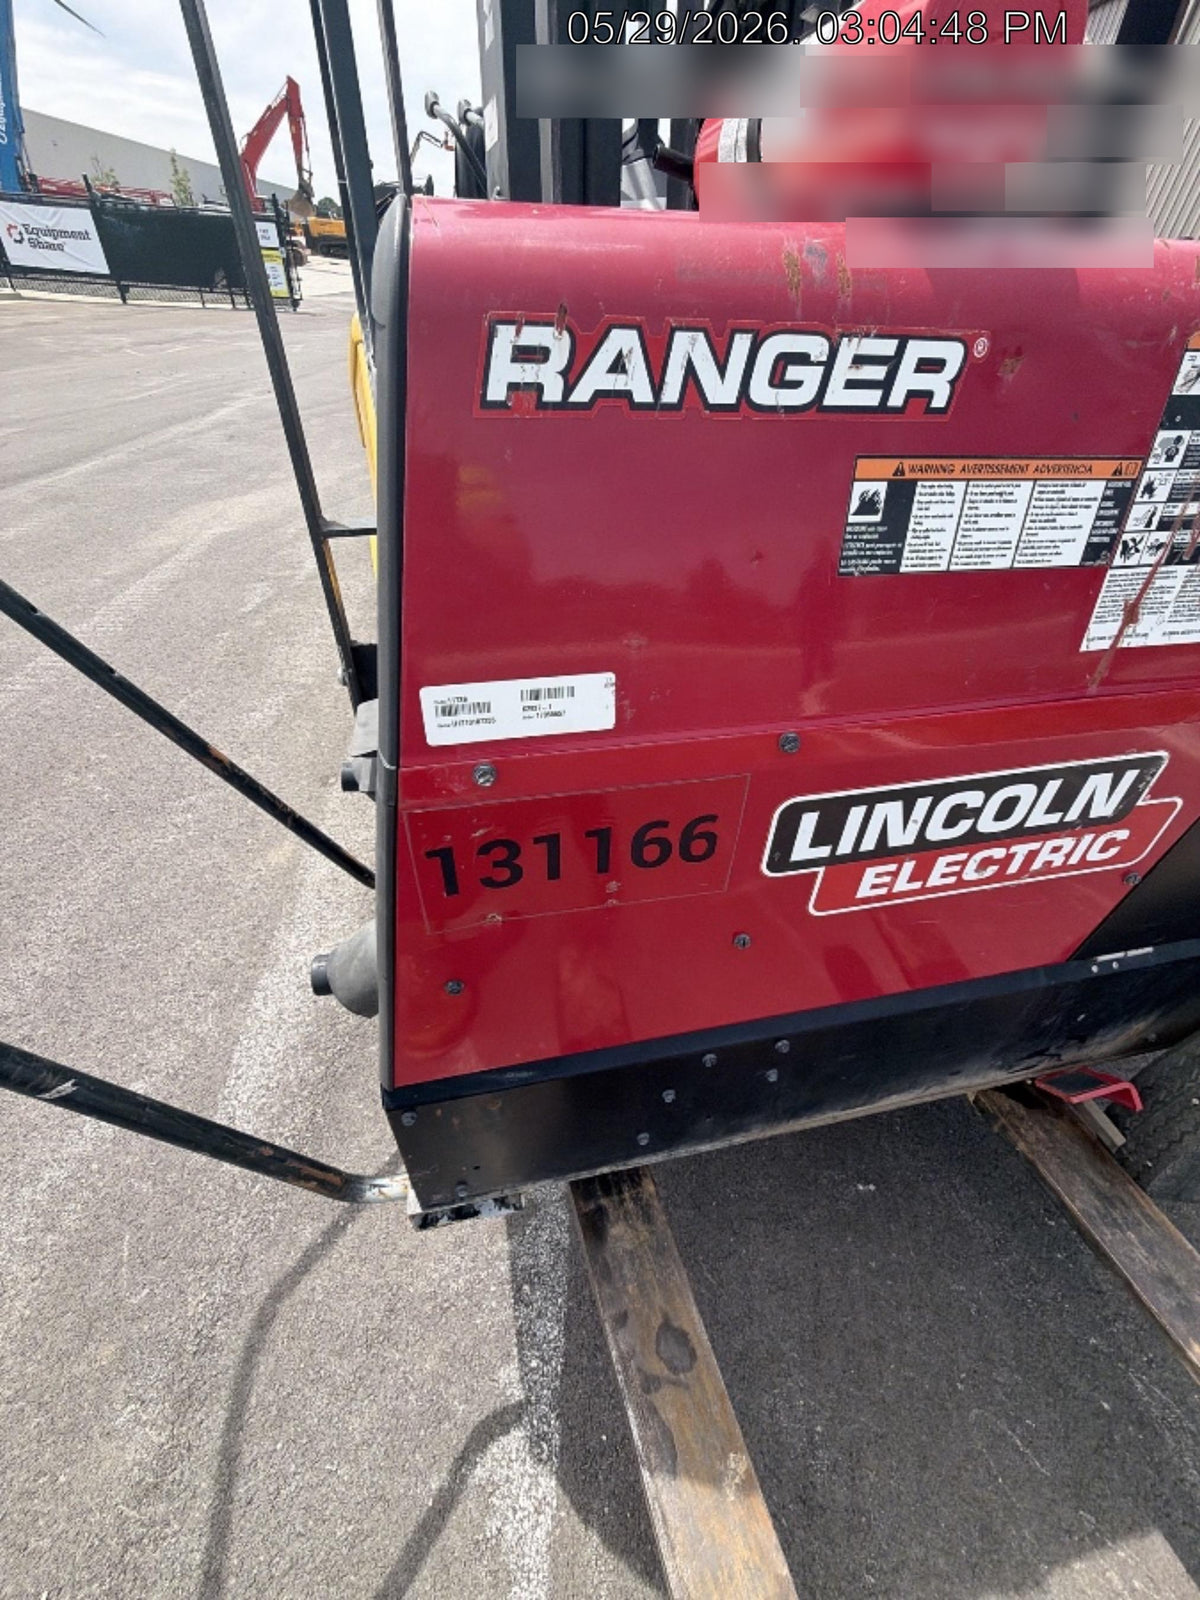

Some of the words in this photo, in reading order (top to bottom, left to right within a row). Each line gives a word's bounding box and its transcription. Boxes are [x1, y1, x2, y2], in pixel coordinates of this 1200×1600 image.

[22, 223, 91, 240] Equipment
[28, 238, 65, 252] Share
[485, 322, 966, 411] RANGER
[908, 463, 955, 475] WARNING
[959, 463, 1029, 475] AVERTISSEMENT
[790, 769, 1140, 862] LINCOLN
[425, 813, 719, 898] 131166
[855, 829, 1131, 899] ELECTRIC
